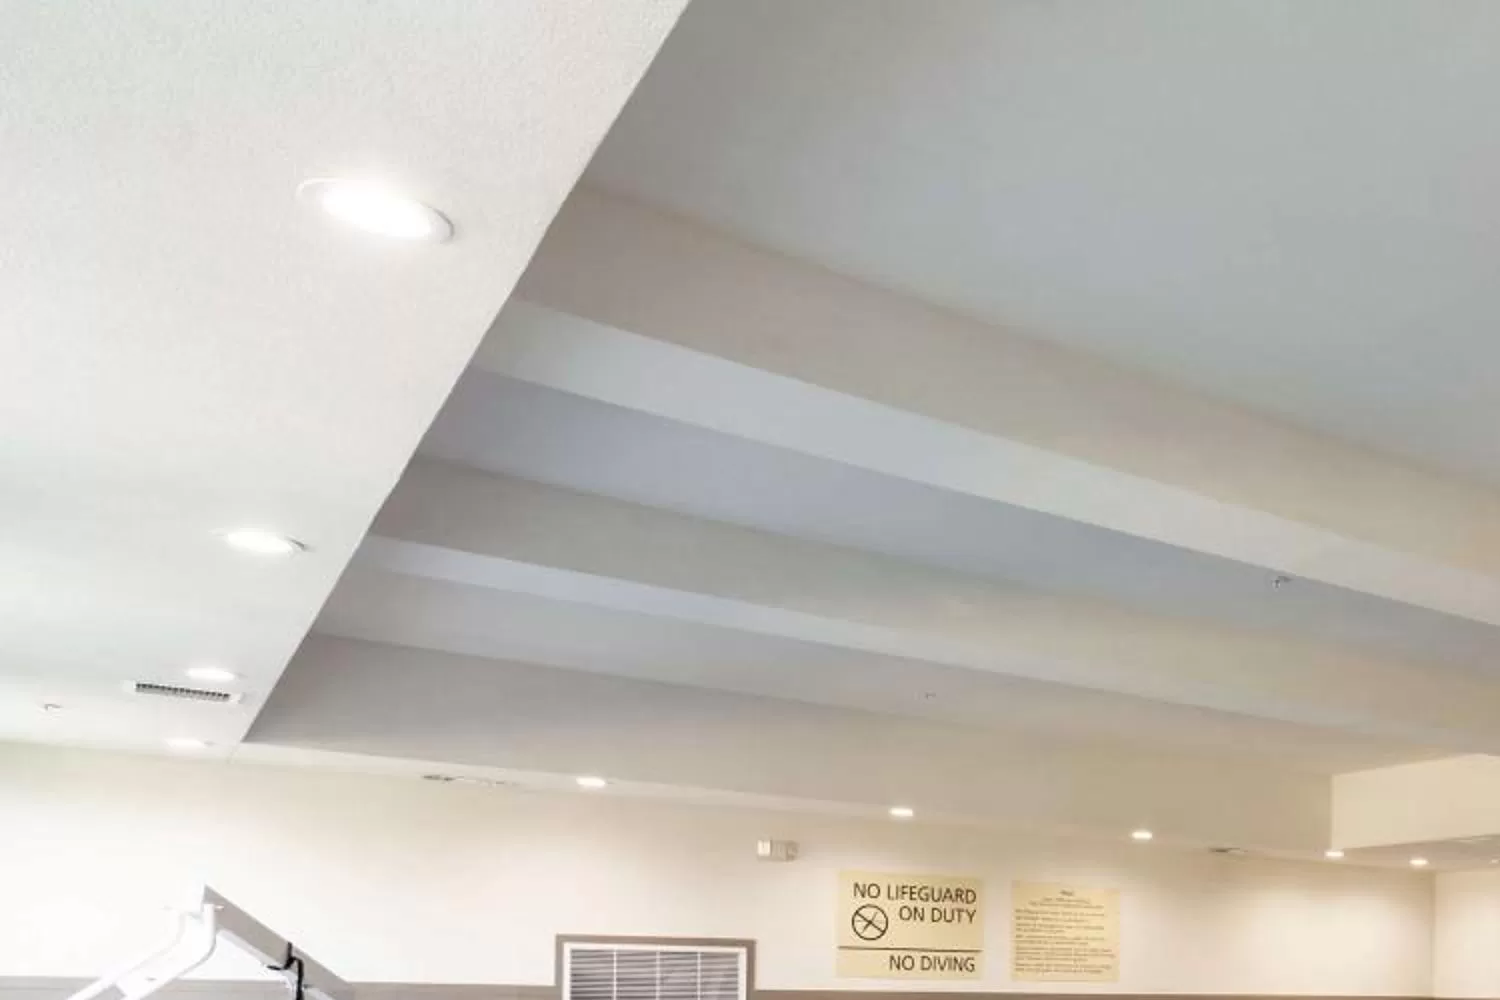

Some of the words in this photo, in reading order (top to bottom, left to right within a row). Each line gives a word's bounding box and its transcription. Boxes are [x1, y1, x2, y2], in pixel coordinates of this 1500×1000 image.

[853, 882, 881, 899] NO
[887, 884, 977, 904] LIFEGUARD
[899, 905, 925, 922] ON
[931, 907, 977, 924] DUTY
[889, 955, 915, 971] NO
[920, 955, 976, 973] DIVING
